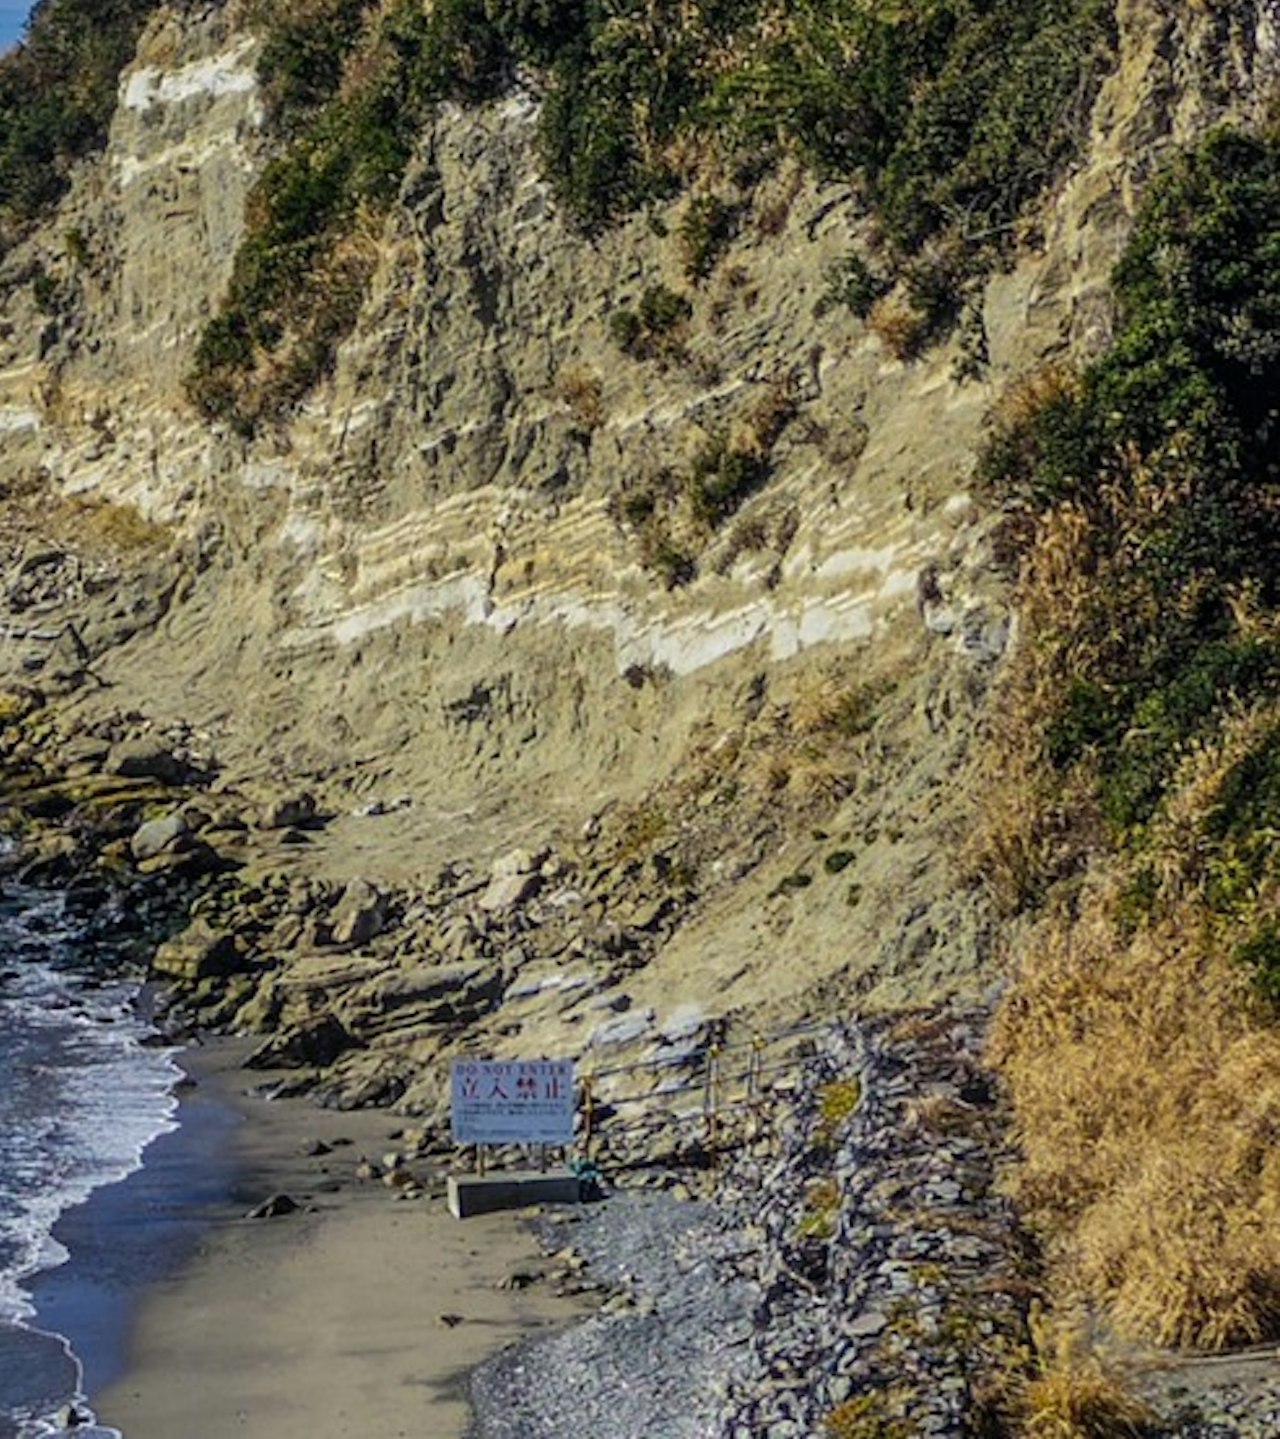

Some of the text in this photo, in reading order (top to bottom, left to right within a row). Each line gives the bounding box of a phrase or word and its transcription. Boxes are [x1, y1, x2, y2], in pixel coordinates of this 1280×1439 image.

[456, 1064, 566, 1075] DO NOT ENTER
[460, 1076, 567, 1099] 立入禁止
